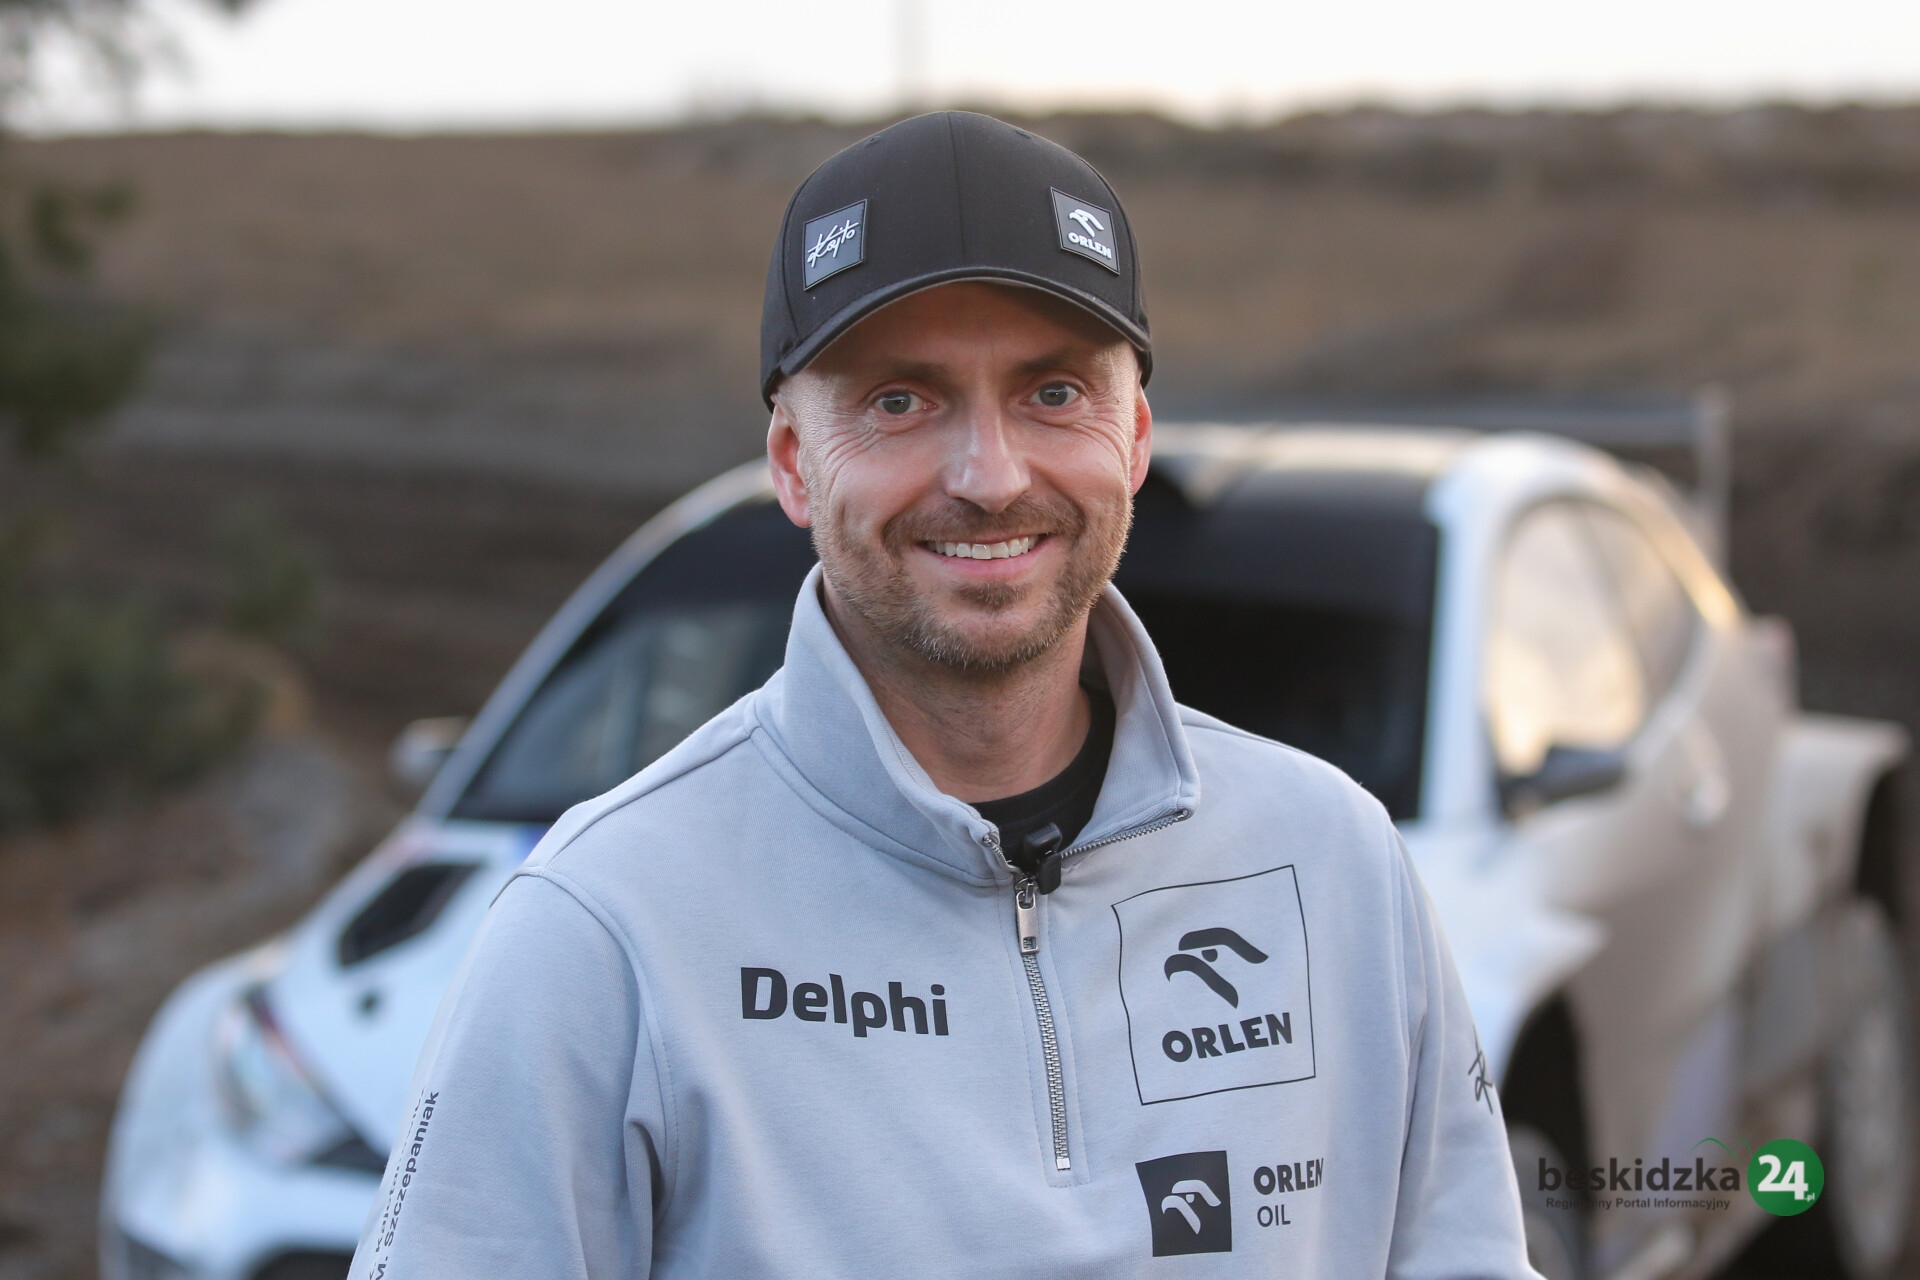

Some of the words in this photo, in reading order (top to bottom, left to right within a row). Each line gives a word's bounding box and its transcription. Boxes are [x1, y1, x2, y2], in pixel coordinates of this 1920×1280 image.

[1068, 232, 1112, 259] ORLEN
[741, 967, 949, 1038] Delphi
[1162, 1012, 1293, 1063] ORLEN
[384, 1091, 440, 1248] Szczepaniak
[1253, 1158, 1324, 1195] ORLEN
[1257, 1204, 1291, 1228] OIL
